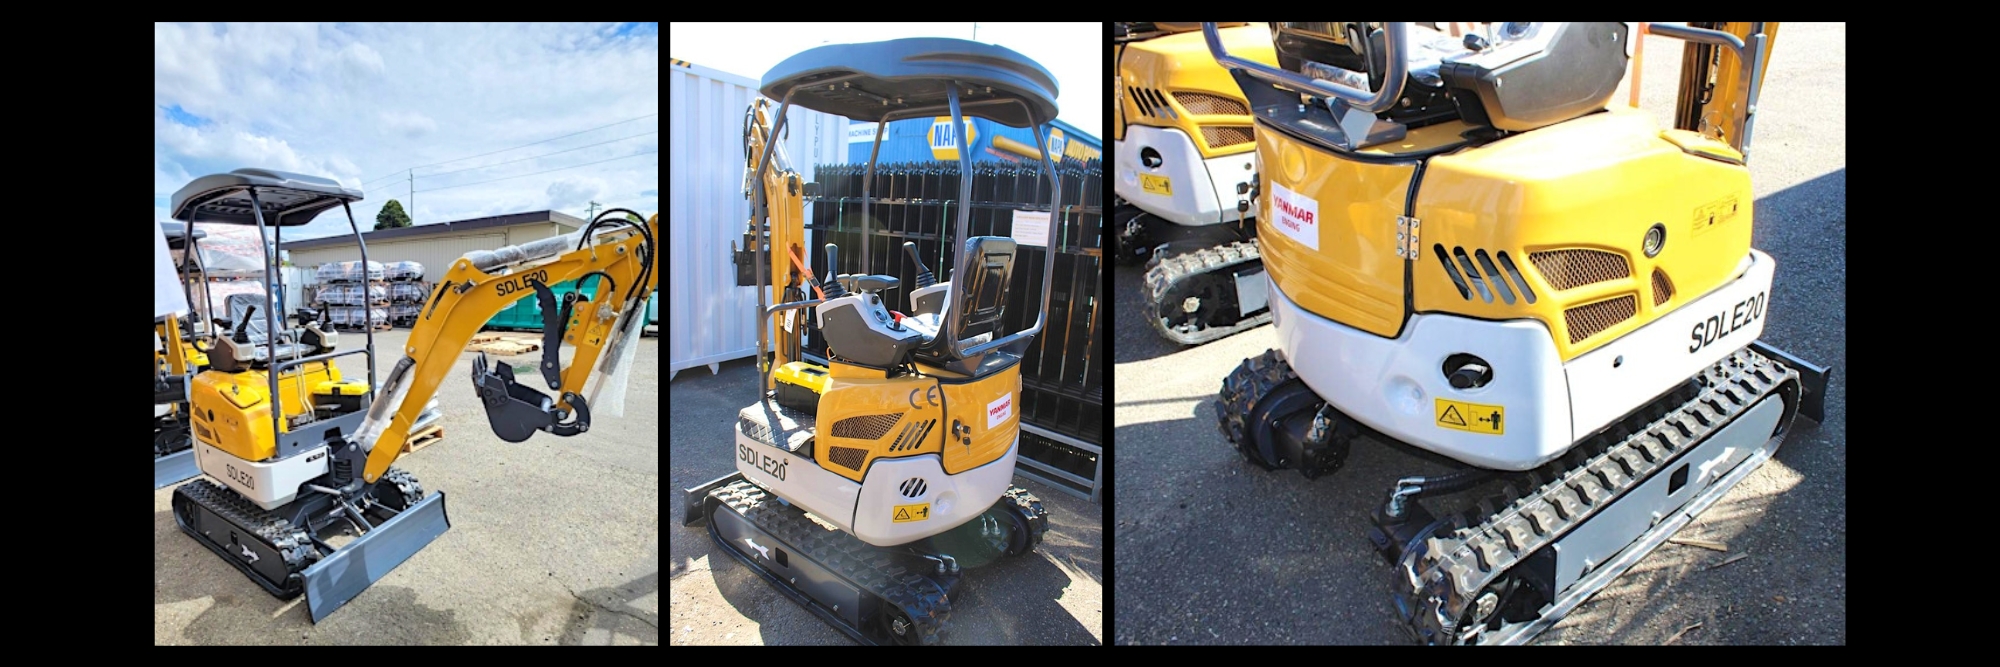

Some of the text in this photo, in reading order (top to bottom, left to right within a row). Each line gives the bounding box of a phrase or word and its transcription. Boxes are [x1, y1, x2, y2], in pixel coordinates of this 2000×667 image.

[1273, 194, 1314, 225] YANMAR
[1689, 291, 1764, 354] SDLE20
[226, 463, 255, 490] SDLE20
[739, 443, 786, 481] SDLE20
